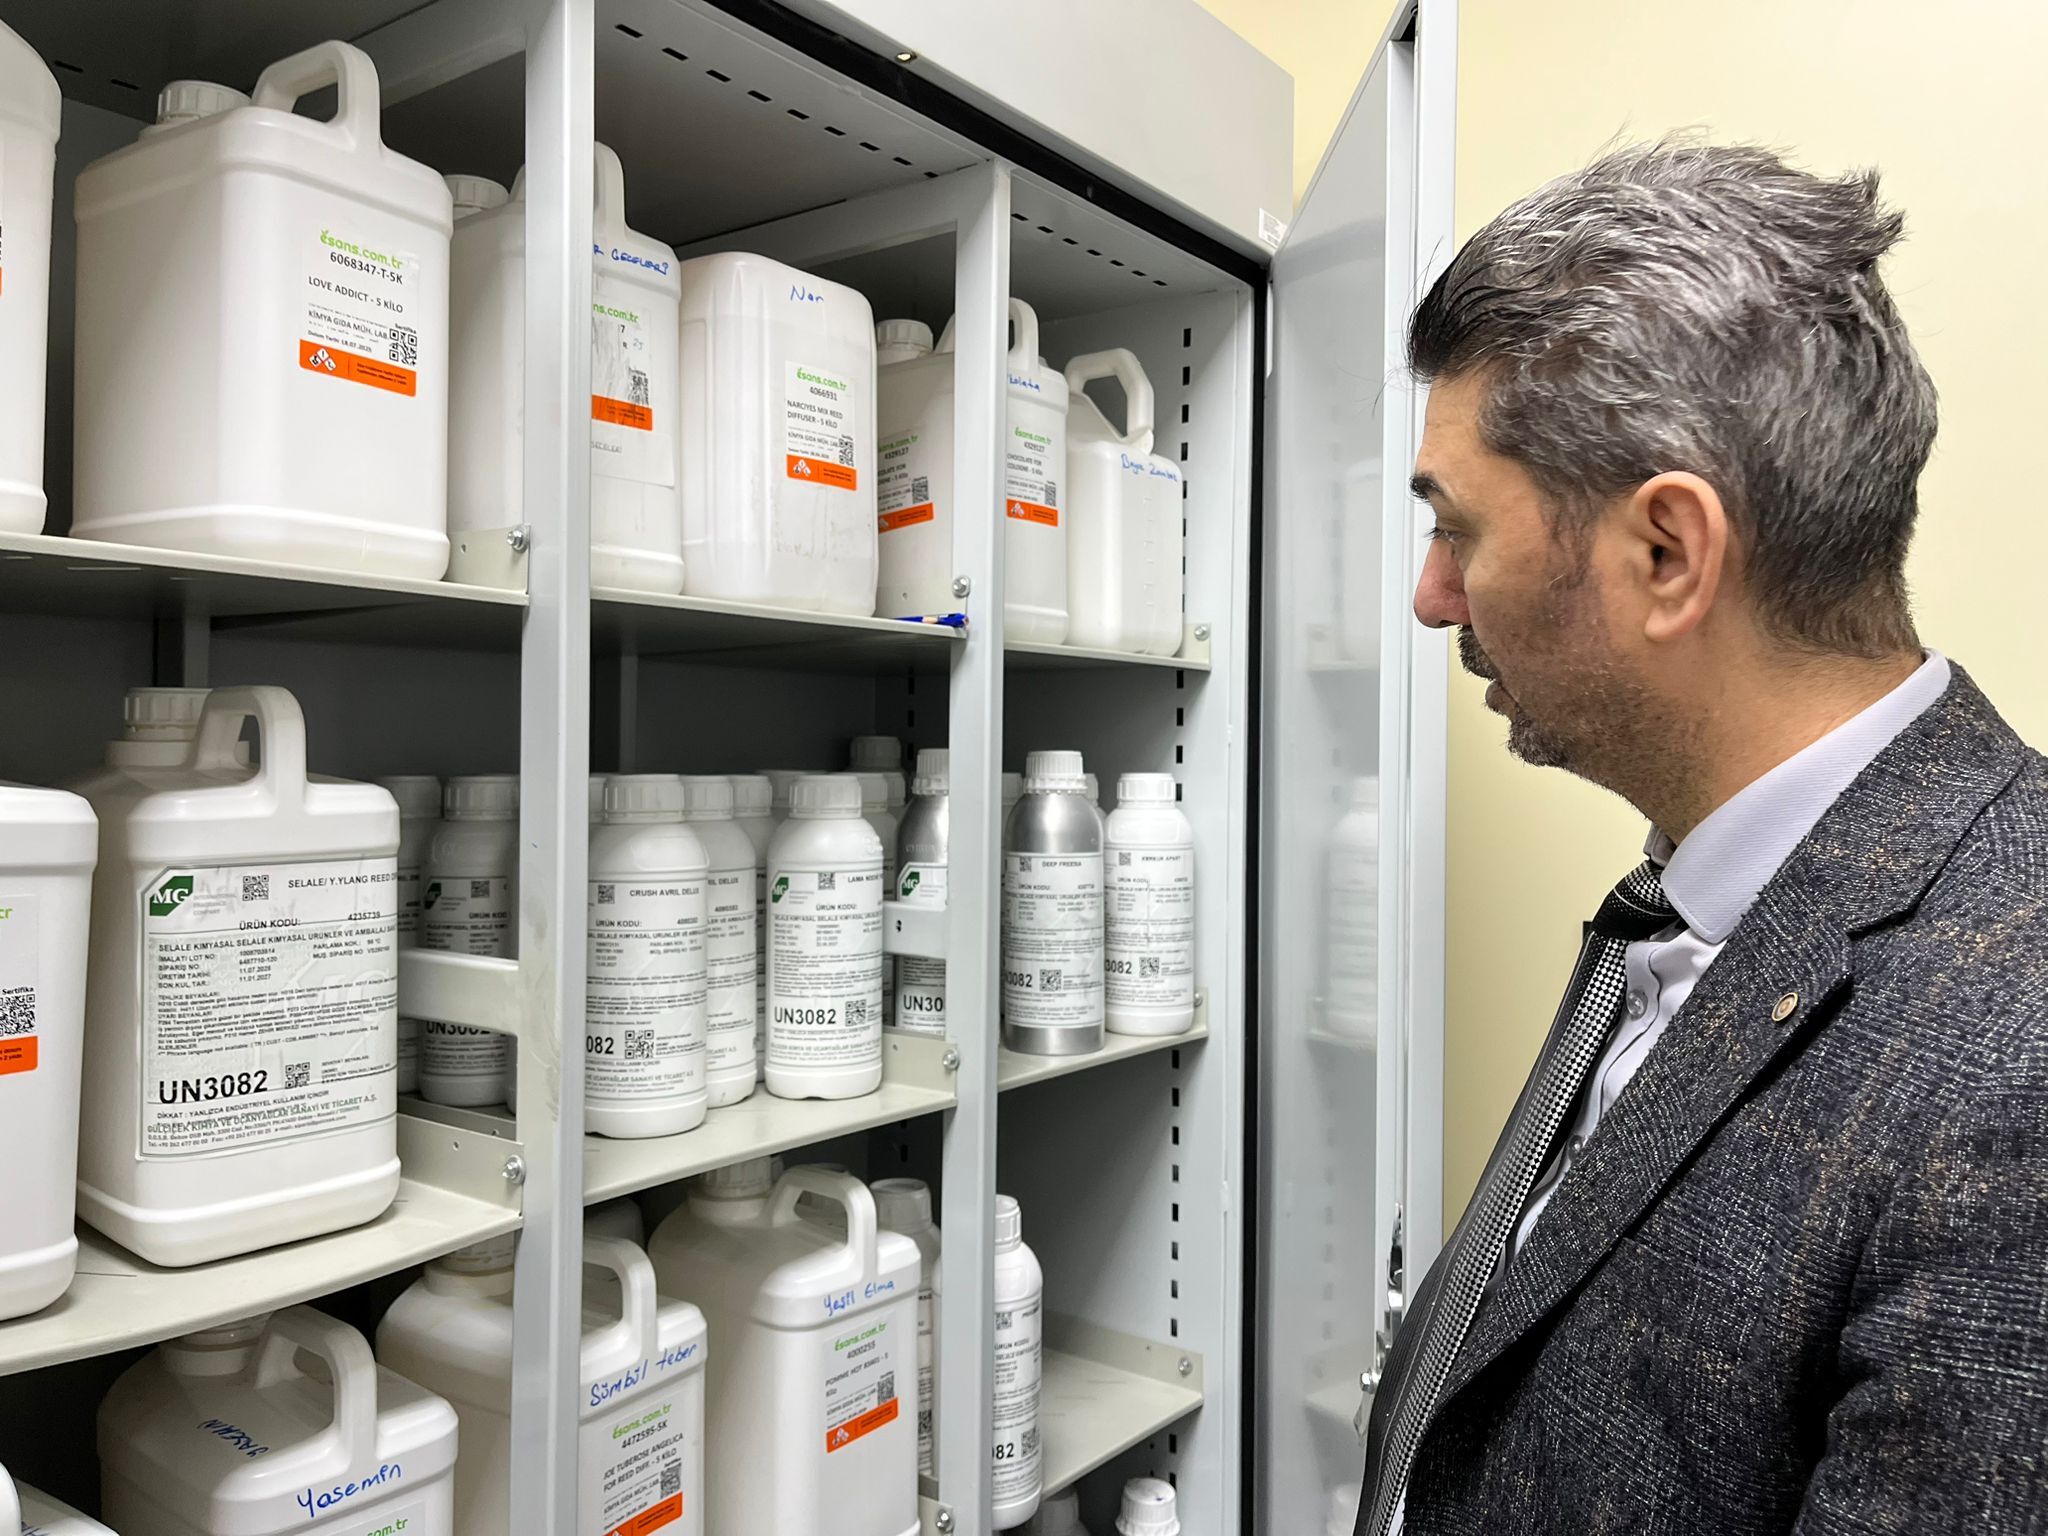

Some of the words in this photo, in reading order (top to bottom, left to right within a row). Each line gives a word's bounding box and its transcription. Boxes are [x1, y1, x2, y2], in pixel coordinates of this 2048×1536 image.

[308, 276, 333, 291] LOVE
[334, 284, 369, 302] ADDICT
[790, 285, 825, 302] Nar
[370, 873, 389, 883] REED
[152, 888, 189, 904] MG
[629, 889, 658, 897] CRUSH
[239, 919, 267, 931] ÜRÜN
[159, 944, 192, 952] SELALE
[193, 940, 235, 950] KIMYASAL
[236, 937, 266, 947] SELALE
[267, 934, 307, 944] KIMYASAL
[344, 928, 353, 936] VE
[2, 986, 35, 996] Sertifika
[903, 994, 944, 1012] UN30
[774, 1006, 837, 1025] UN3082
[159, 1070, 268, 1104] UN3082
[864, 1280, 895, 1298] Elma
[992, 1442, 1014, 1460] 82
[296, 1464, 401, 1518] Yasemin
